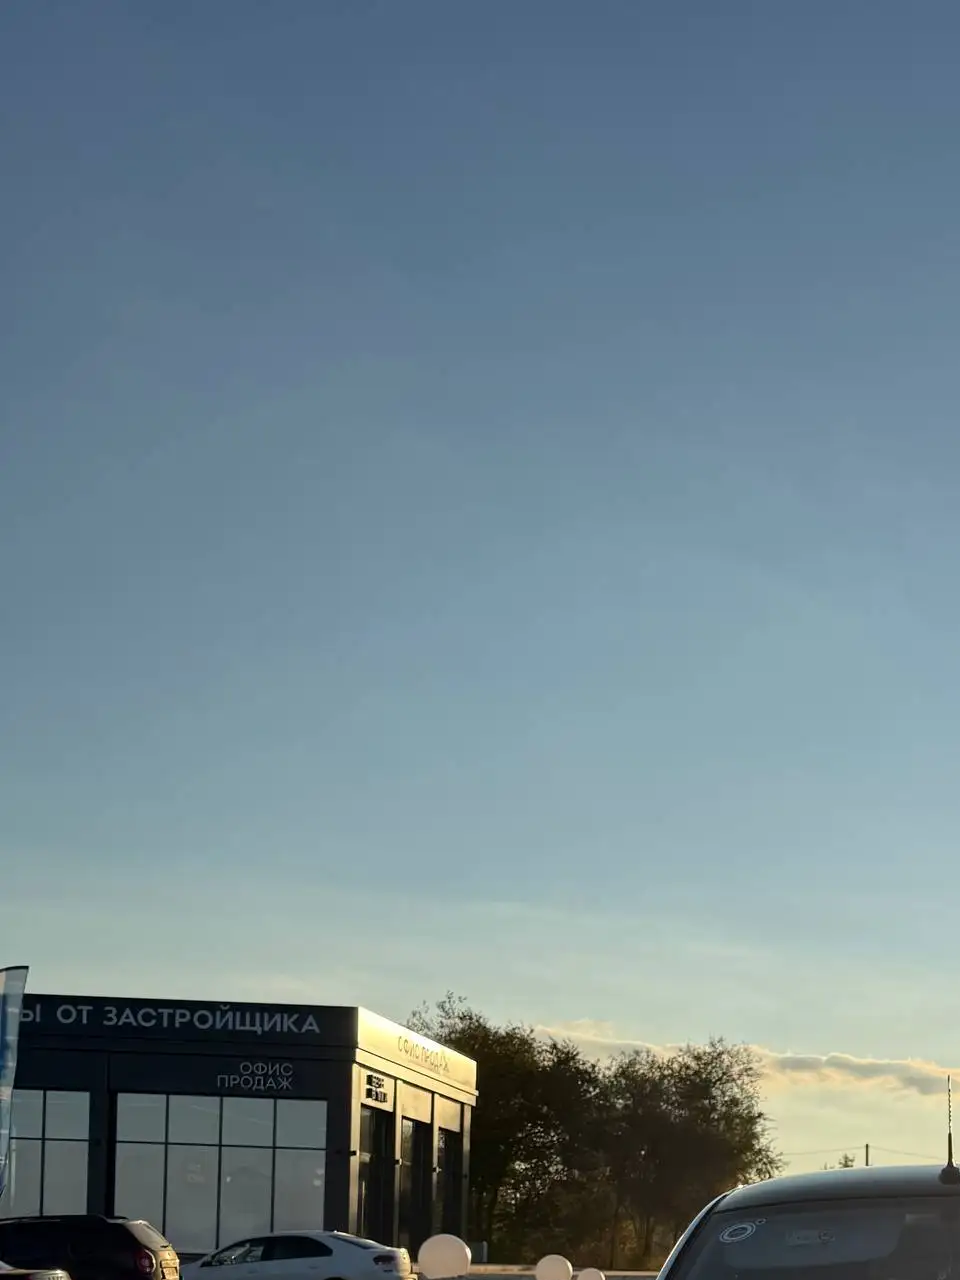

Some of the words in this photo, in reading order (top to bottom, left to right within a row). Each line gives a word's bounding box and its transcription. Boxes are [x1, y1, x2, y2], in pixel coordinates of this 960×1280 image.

[56, 1004, 94, 1025] ОТ
[102, 1005, 321, 1035] ЗАСТРОЙЩИКА
[239, 1062, 293, 1076] ОФИС
[217, 1075, 293, 1090] ПРОДАЖ
